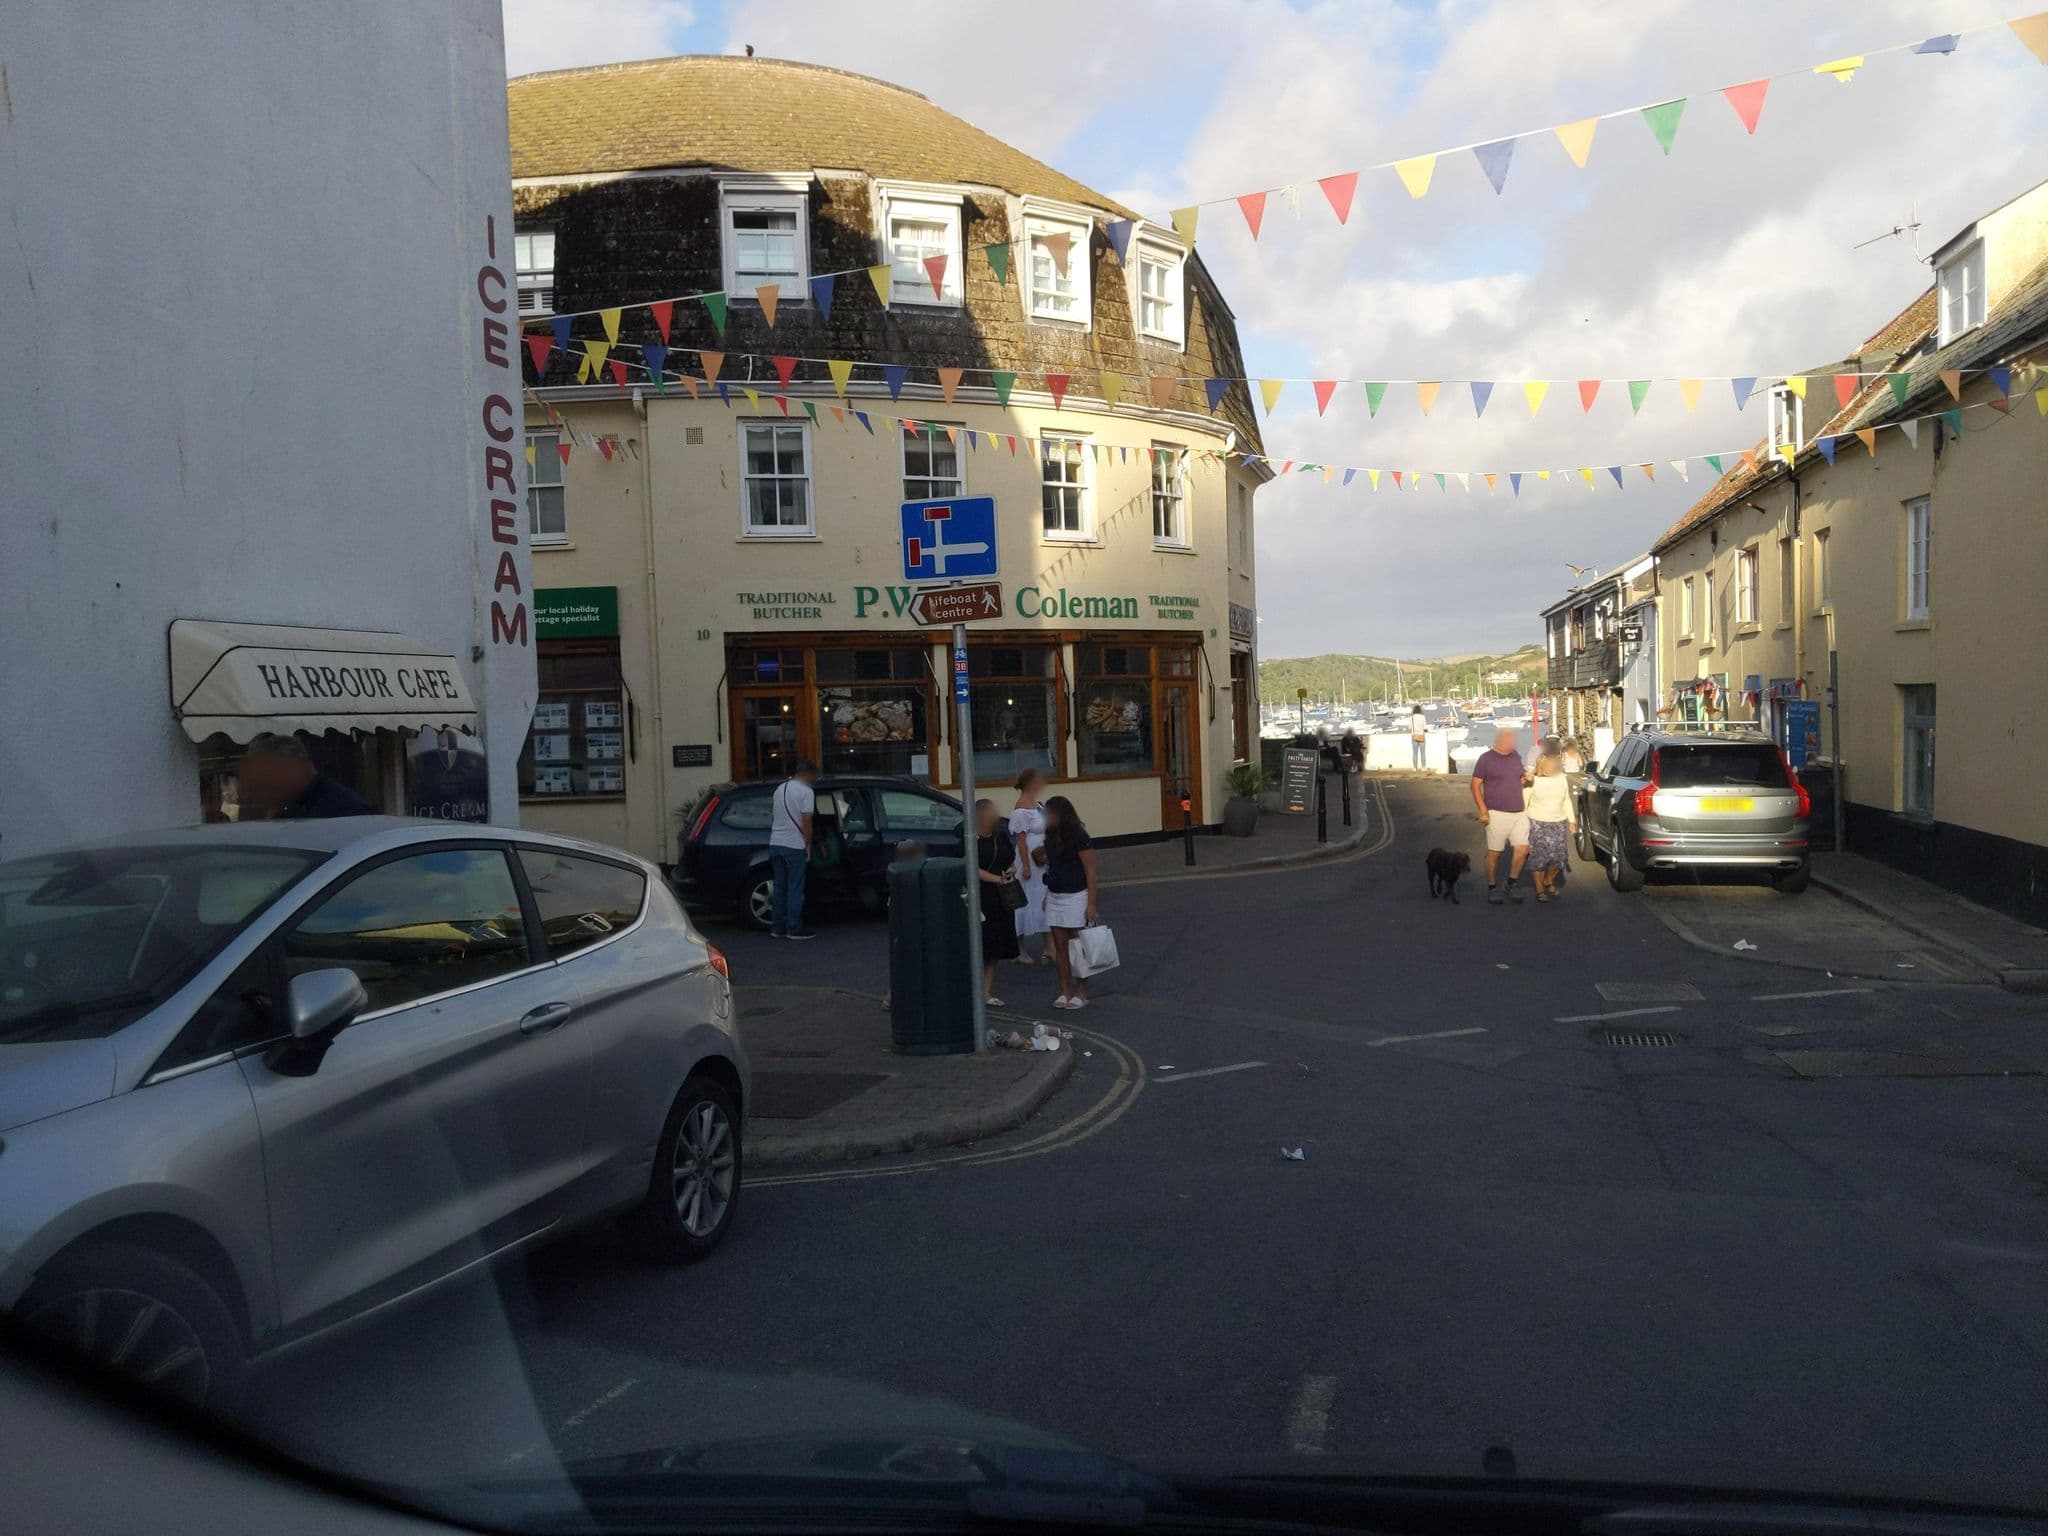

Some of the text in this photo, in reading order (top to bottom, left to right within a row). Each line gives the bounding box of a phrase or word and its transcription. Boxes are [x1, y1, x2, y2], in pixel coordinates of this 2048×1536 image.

[477, 214, 529, 648] ICE CREAM
[737, 592, 837, 604] TRADITIONAL
[1015, 586, 1139, 619] Coleman
[1149, 595, 1200, 608] TRADITIONAL
[549, 606, 568, 614] local
[570, 605, 600, 616] holiday
[753, 607, 823, 620] BUTCHER
[935, 607, 973, 619] centre
[1158, 609, 1194, 620] BUTCHER
[534, 614, 600, 625] ottage specialist
[697, 629, 710, 641] 10
[257, 664, 459, 699] HARBOUR CAFE
